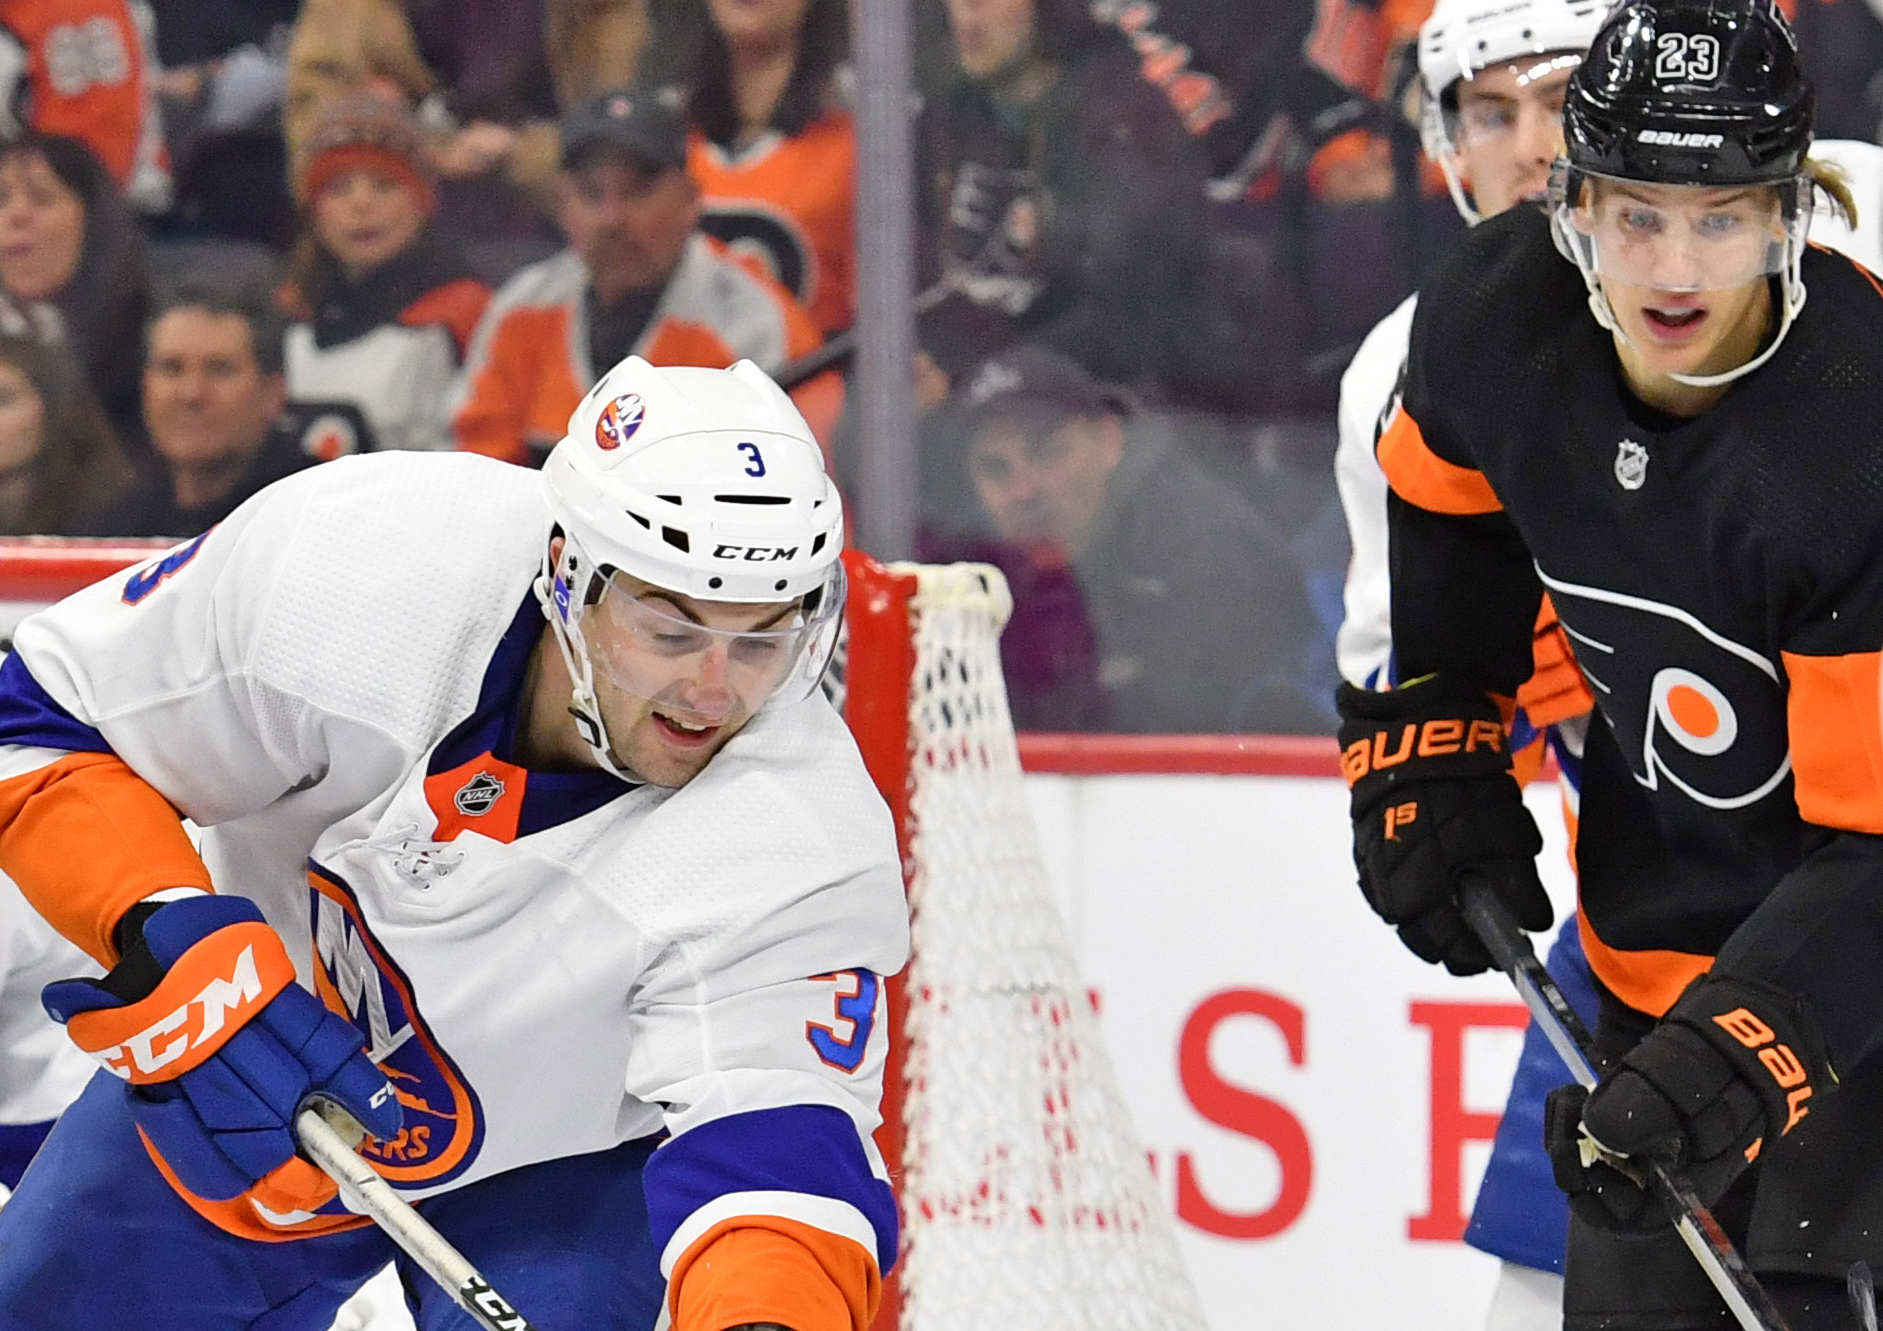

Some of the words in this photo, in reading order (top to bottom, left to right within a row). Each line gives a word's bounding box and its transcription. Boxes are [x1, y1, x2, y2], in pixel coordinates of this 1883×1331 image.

[1655, 33, 1720, 81] 23
[737, 442, 766, 478] 3
[712, 544, 800, 562] CCM
[1340, 718, 1503, 790] AUER
[462, 789, 494, 801] NHL
[90, 944, 263, 1081] CCM
[805, 966, 881, 1075] 3
